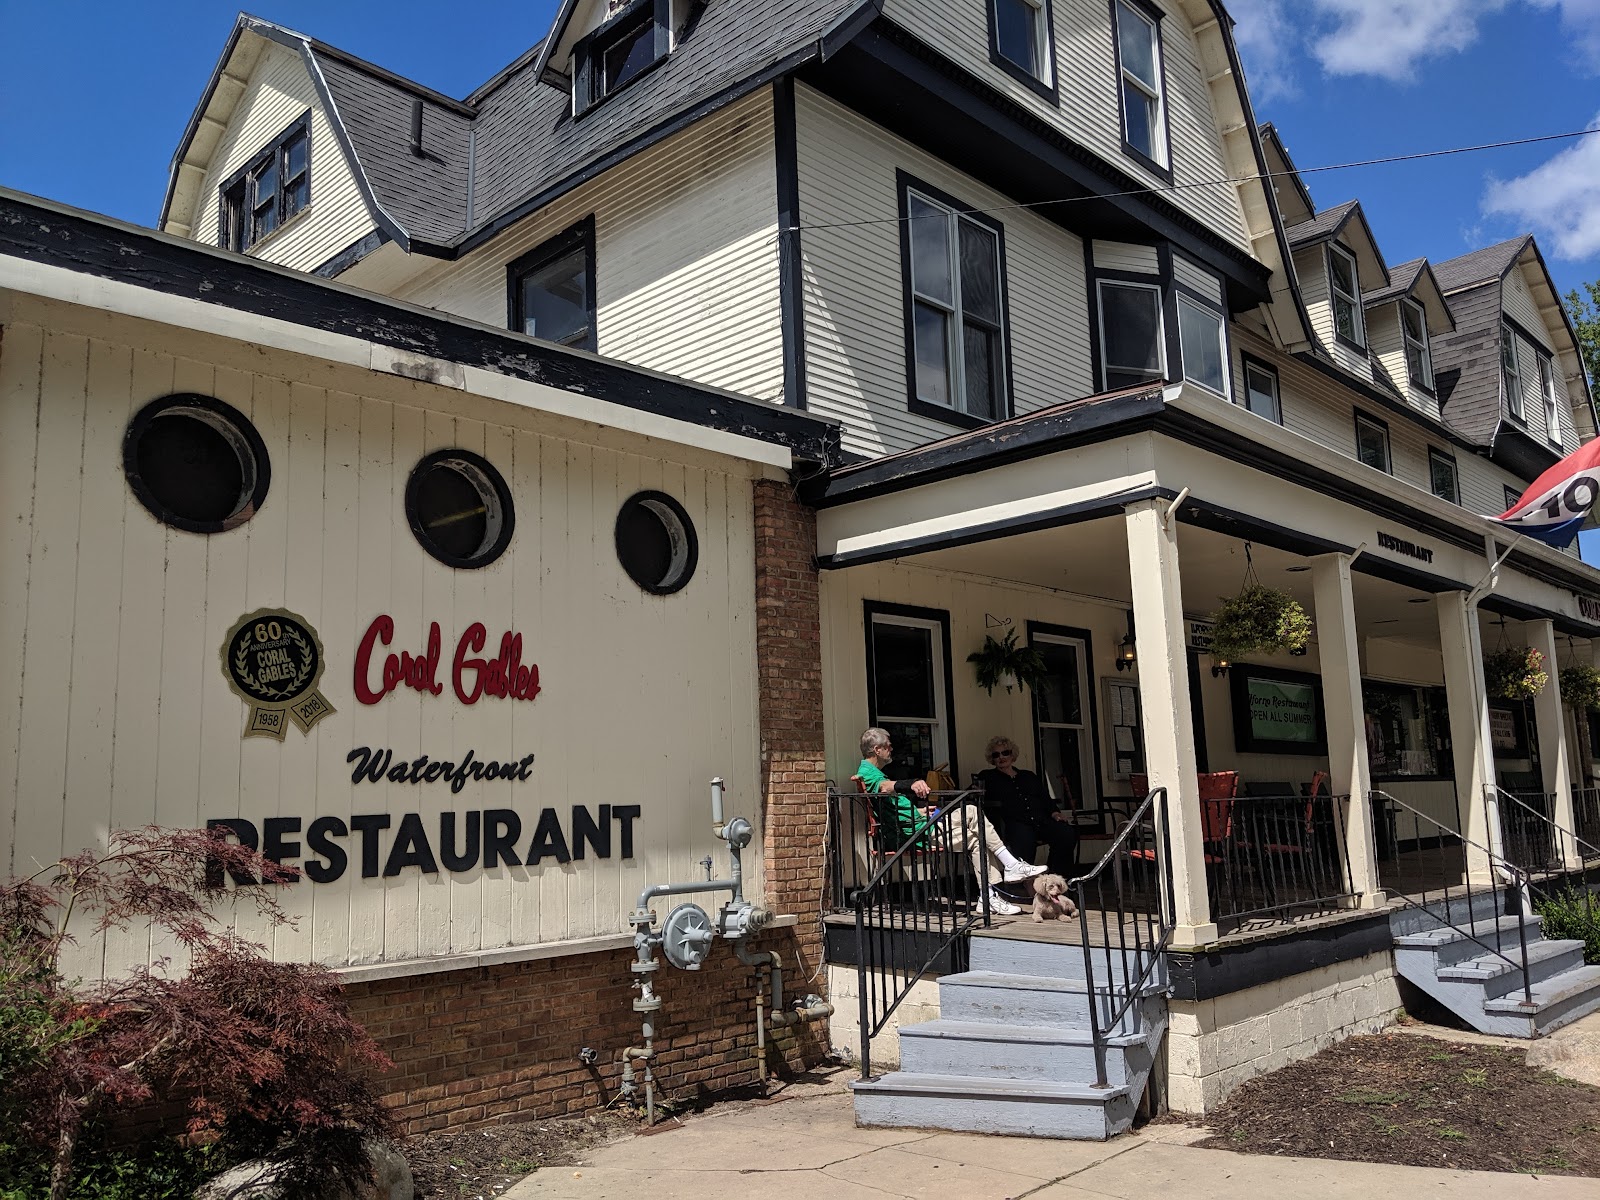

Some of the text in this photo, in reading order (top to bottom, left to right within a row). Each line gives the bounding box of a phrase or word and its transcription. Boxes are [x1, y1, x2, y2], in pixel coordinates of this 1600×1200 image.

[1376, 531, 1433, 564] RESTAURANT
[249, 637, 291, 652] ANNIVERSARY
[256, 647, 291, 668] CORAL
[354, 614, 541, 705] Coral Gables
[257, 661, 297, 684] GABLES
[258, 713, 279, 727] 1958
[300, 699, 321, 719] 2018
[1250, 709, 1312, 724] OPEN ALL SUMMER
[346, 746, 535, 794] Waterfront
[206, 803, 641, 886] RESTAURANT
